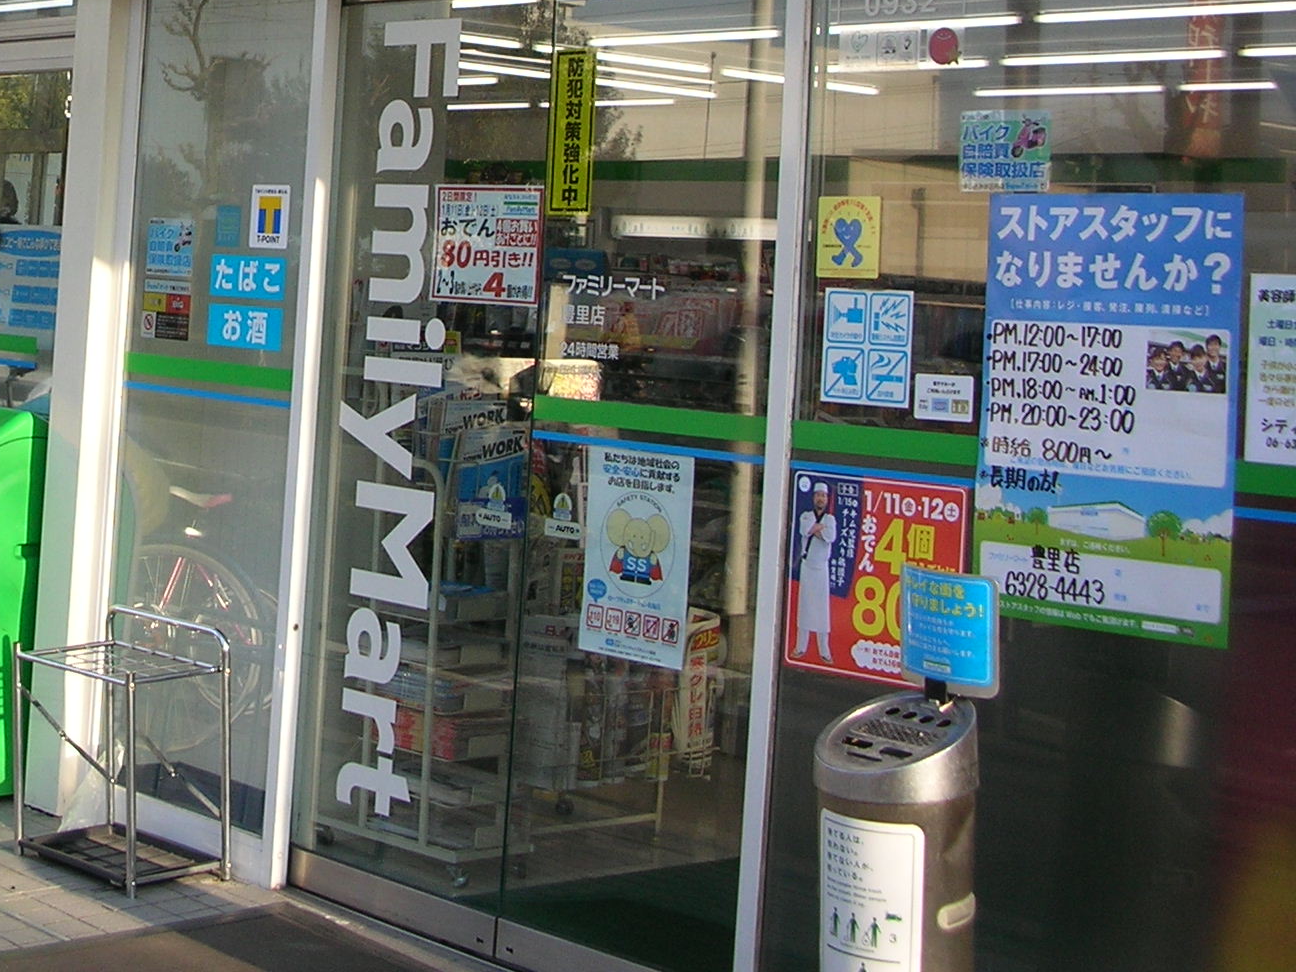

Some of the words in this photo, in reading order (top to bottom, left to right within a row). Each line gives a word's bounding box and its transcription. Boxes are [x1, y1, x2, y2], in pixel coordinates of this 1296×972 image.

[561, 58, 584, 207] 防犯対策強化中
[962, 124, 1010, 141] バイク
[962, 143, 1010, 159] 自賠責
[961, 161, 1046, 178] 保険取扱店
[149, 228, 174, 239] バイク
[440, 217, 495, 238] おでん
[997, 204, 1233, 243] ストアスタッフに
[256, 235, 281, 244] T-POINT
[440, 239, 535, 268] 80円引き!!
[214, 258, 281, 292] たばこ
[995, 249, 1232, 295] なりませんか?
[562, 273, 666, 301] ファミリーマート
[222, 310, 268, 345] お酒
[559, 341, 620, 360] 24時間営業
[336, 18, 462, 817] FamilyMart
[462, 408, 506, 429] WORK
[482, 435, 524, 459] WORK
[604, 452, 680, 470] 私たちは地域社会の
[616, 494, 639, 507] SAFETY
[639, 494, 663, 514] STATION
[482, 513, 502, 523] AUTO
[555, 524, 576, 534] AUTO
[858, 515, 878, 574] おでん
[626, 557, 648, 573] SS
[1030, 544, 1081, 575] 豊里店
[1005, 570, 1105, 605] 6328-4443
